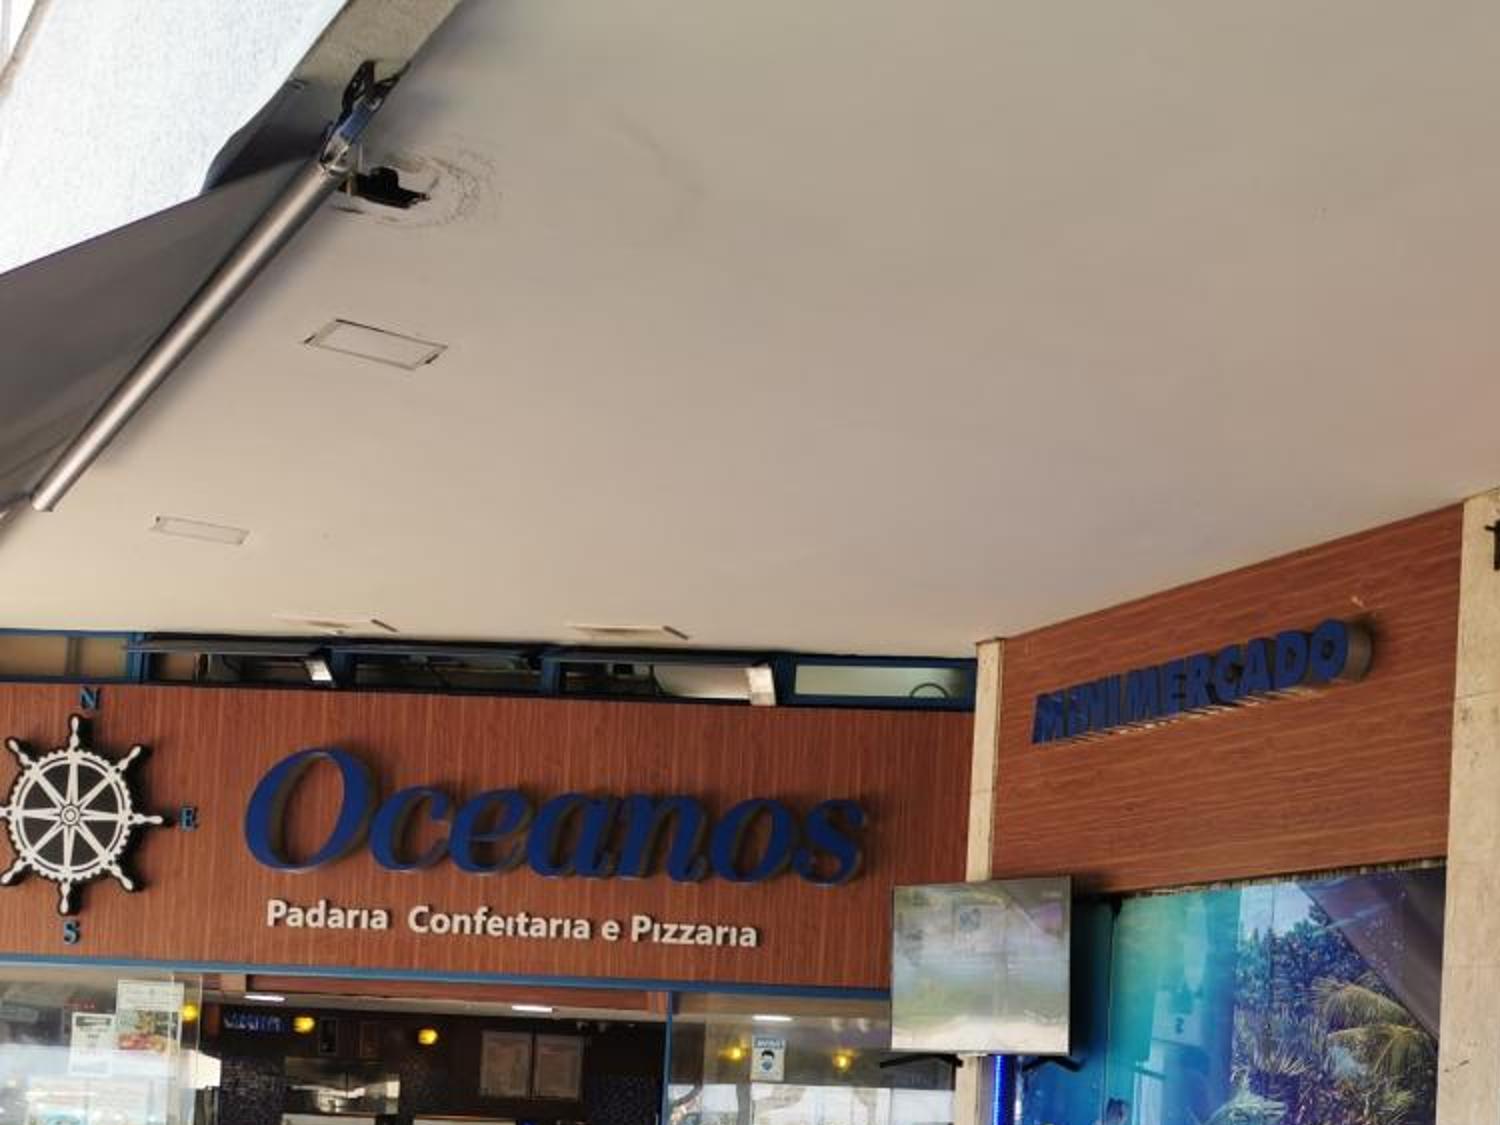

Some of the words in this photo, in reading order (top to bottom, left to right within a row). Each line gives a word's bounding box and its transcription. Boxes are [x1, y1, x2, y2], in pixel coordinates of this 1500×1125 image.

[80, 688, 100, 710] N
[181, 805, 198, 831] E
[244, 746, 866, 888] Oceanos
[63, 920, 80, 944] S
[266, 900, 389, 930] Padaria
[408, 905, 591, 938] Confeitaria
[602, 922, 620, 940] e
[631, 915, 758, 947] Pizzaria
